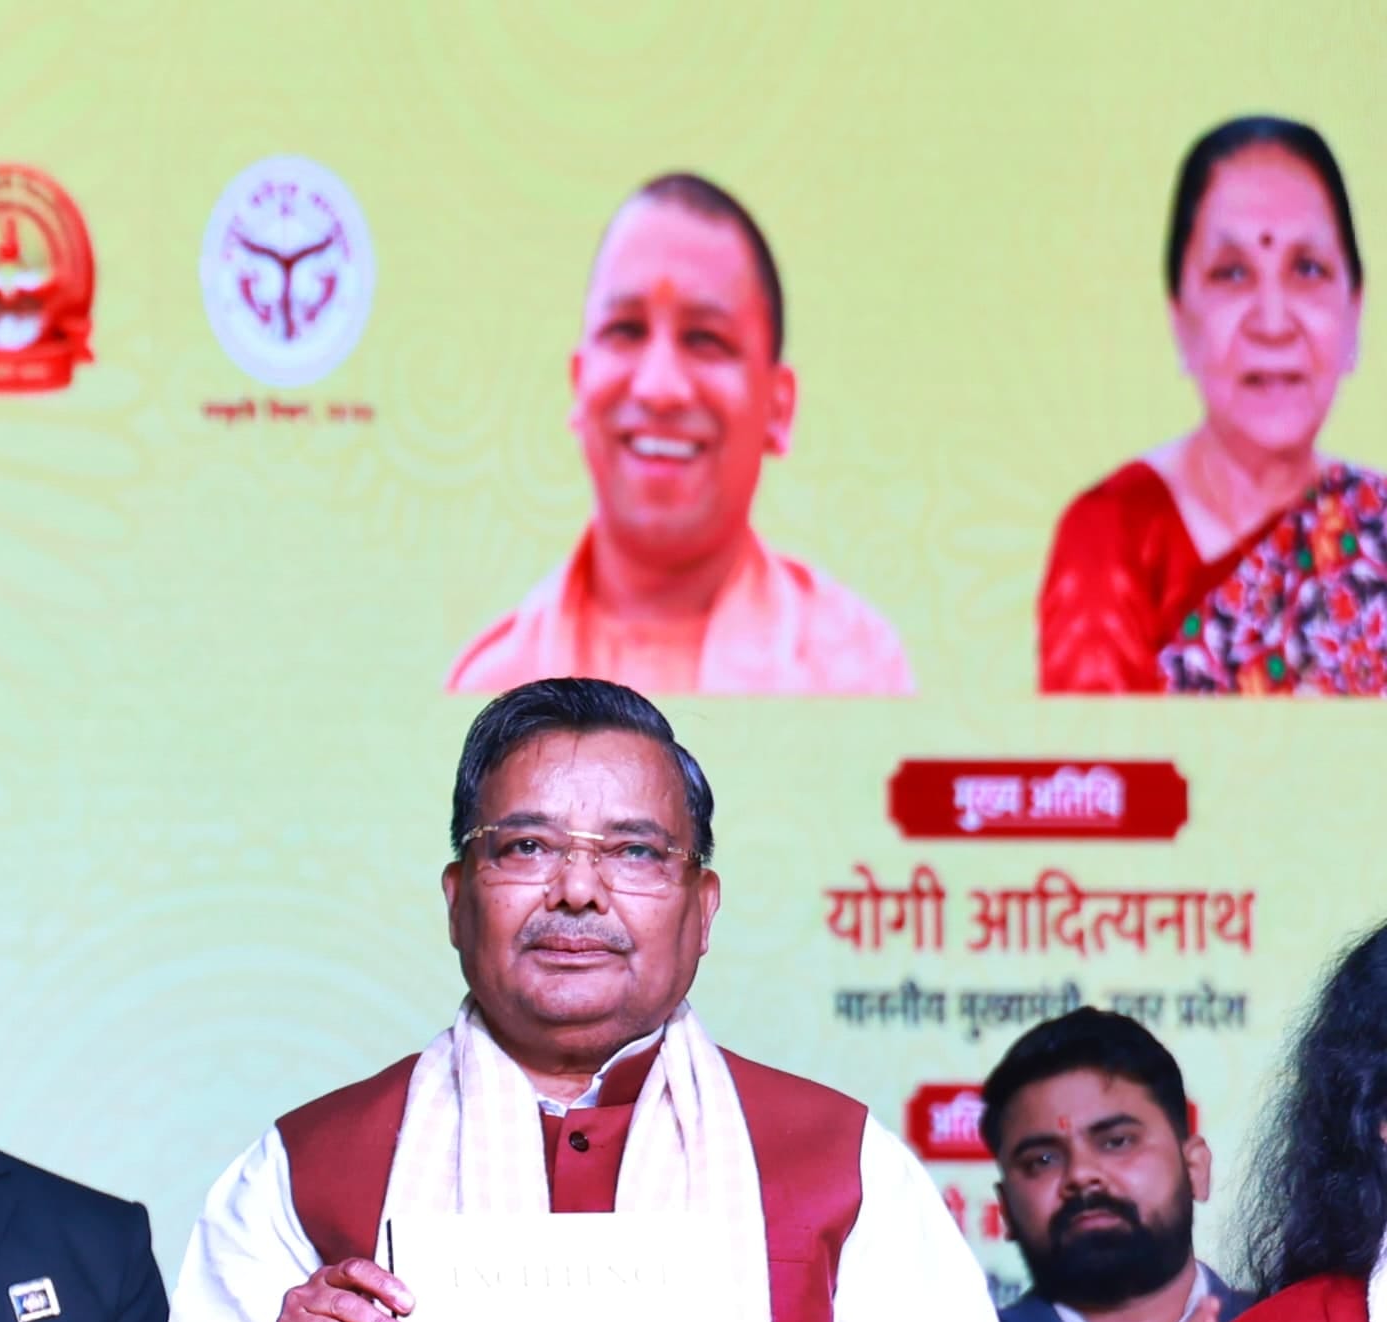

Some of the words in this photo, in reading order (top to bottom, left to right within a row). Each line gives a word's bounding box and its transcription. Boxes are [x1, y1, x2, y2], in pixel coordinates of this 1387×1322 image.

[954, 775, 1024, 832] मुख्य
[1029, 766, 1125, 818] अतिथि
[824, 864, 945, 952] योगी
[968, 869, 1255, 956] आदित्यनाथ
